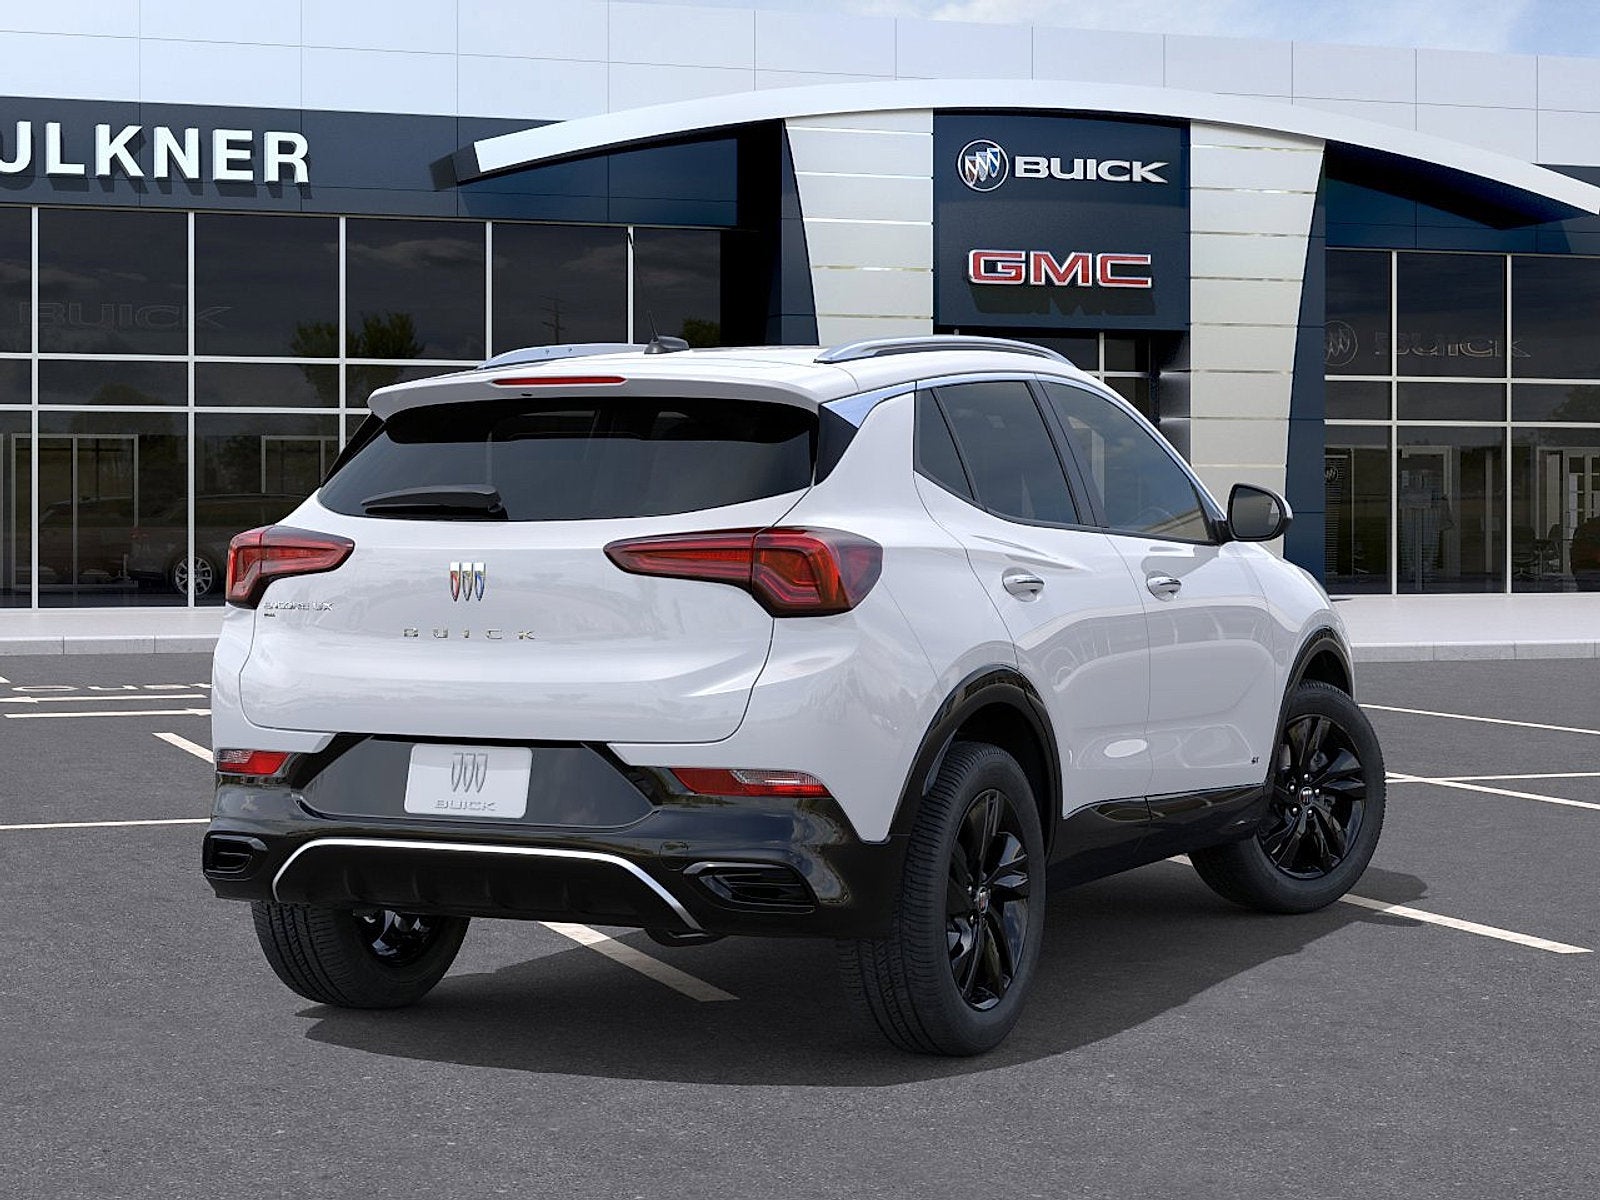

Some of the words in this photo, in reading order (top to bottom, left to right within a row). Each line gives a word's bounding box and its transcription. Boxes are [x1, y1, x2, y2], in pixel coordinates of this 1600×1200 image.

[1014, 155, 1170, 184] BUICK
[968, 249, 1152, 288] GMC
[403, 626, 536, 640] BUICK
[434, 799, 497, 811] BUICK
